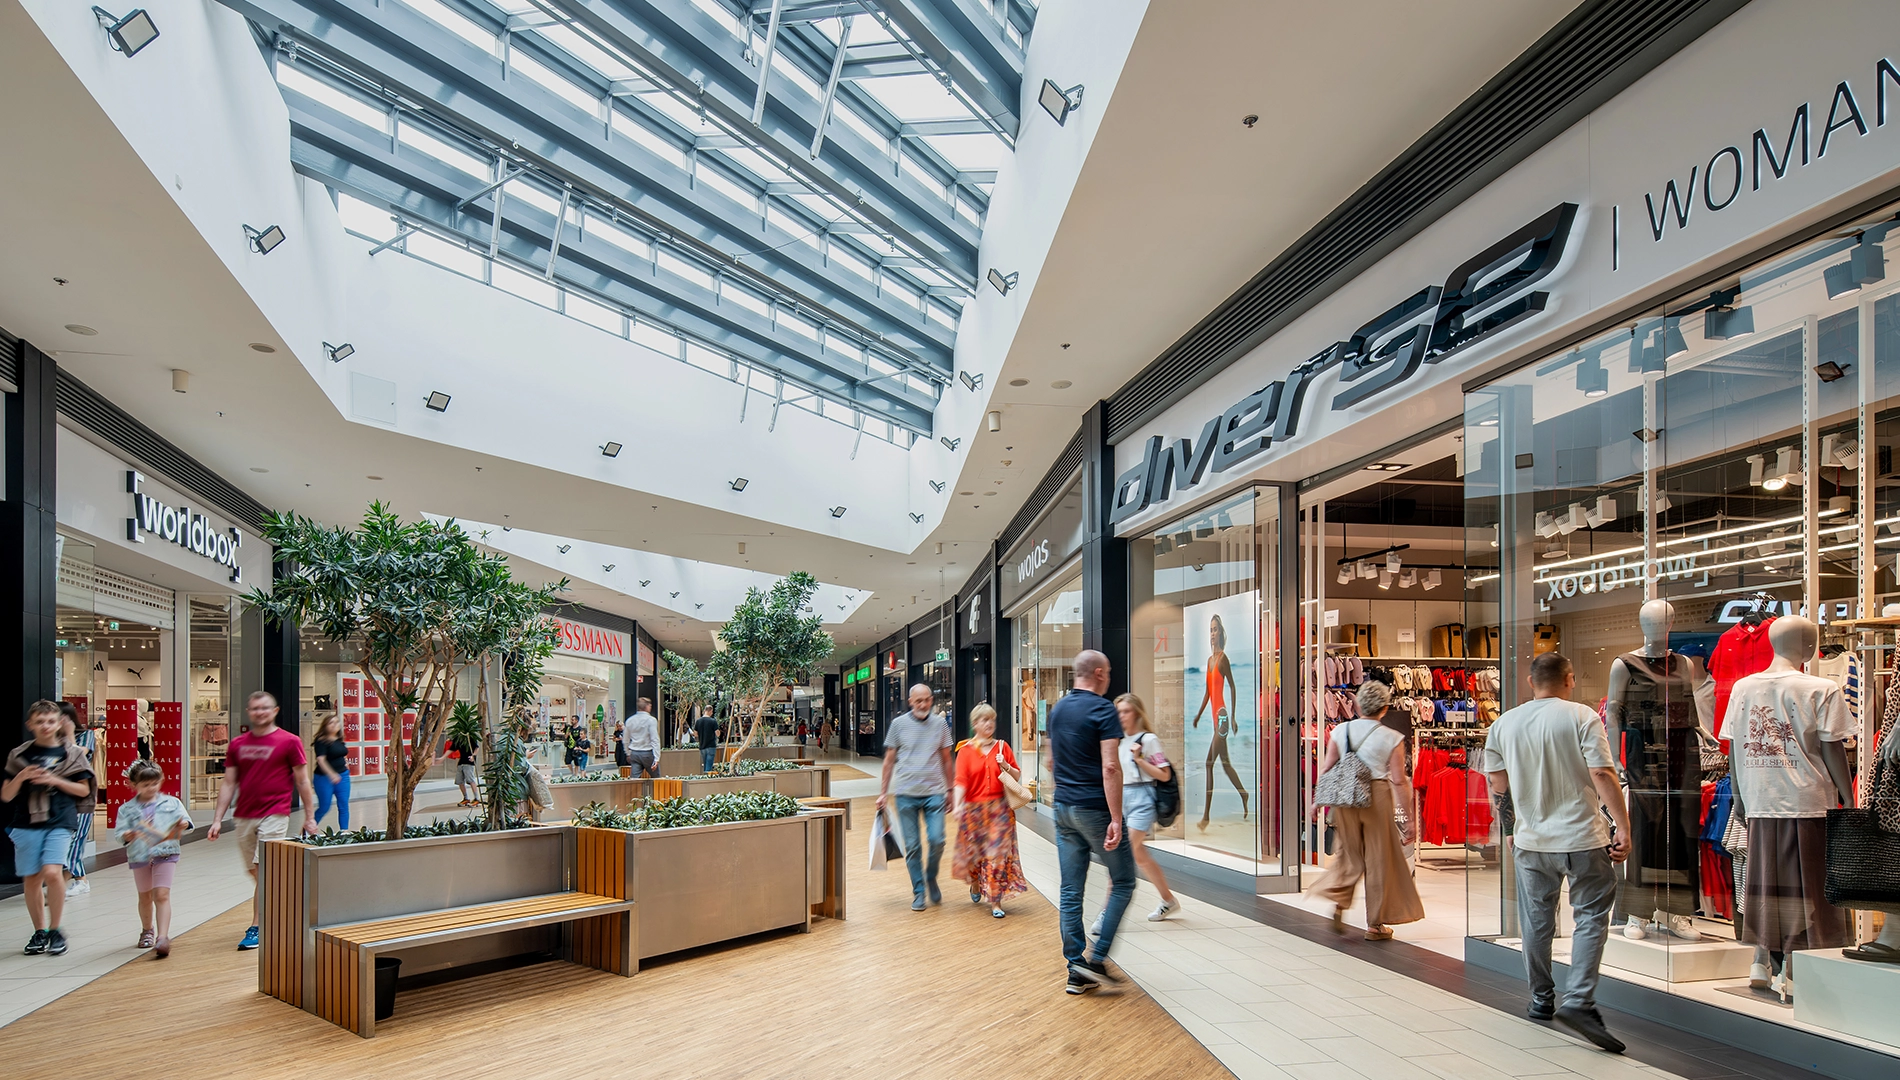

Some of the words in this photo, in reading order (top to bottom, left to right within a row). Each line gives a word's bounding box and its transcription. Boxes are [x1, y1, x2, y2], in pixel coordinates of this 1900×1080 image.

[1109, 201, 1579, 524] diverse
[1017, 538, 1049, 583] wojas
[343, 688, 358, 697] SALE
[365, 756, 379, 765] SALE
